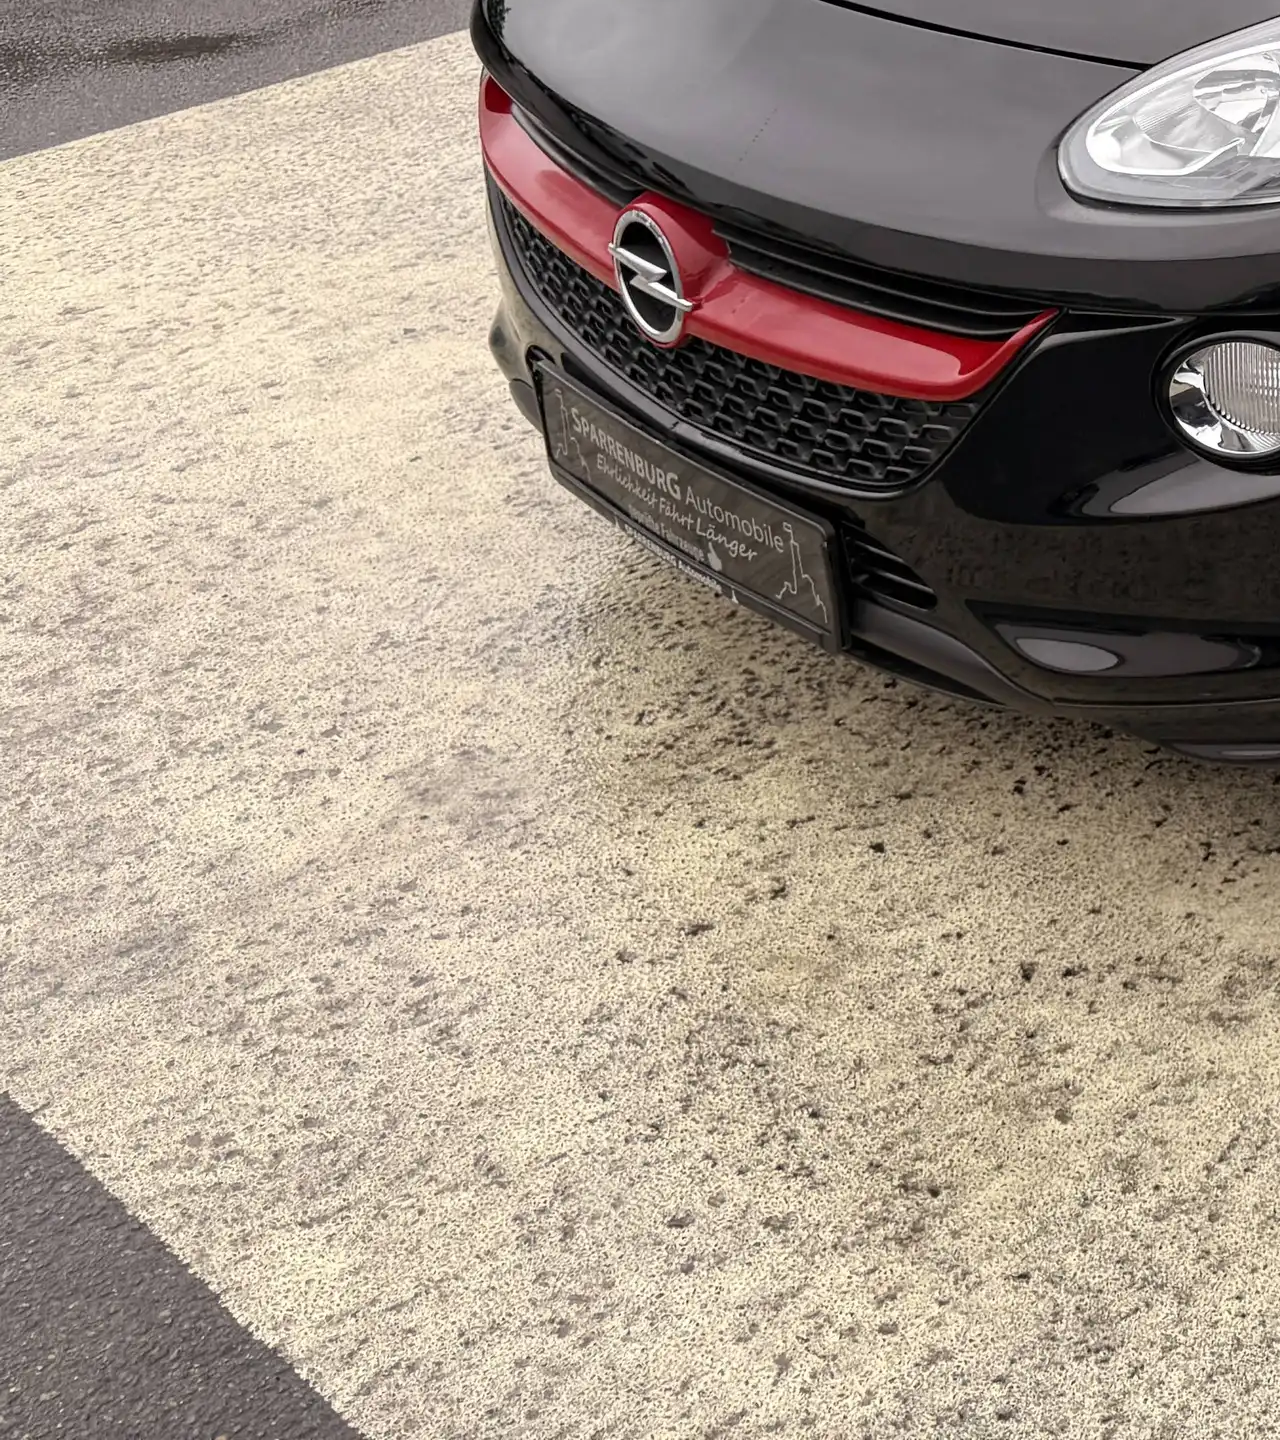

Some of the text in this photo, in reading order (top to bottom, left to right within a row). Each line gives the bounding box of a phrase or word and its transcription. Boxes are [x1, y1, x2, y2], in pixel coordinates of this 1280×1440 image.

[570, 406, 682, 501] SPARRENBURG
[684, 485, 785, 554] Automobile
[659, 496, 695, 531] Fährt
[695, 517, 759, 562] Länger
